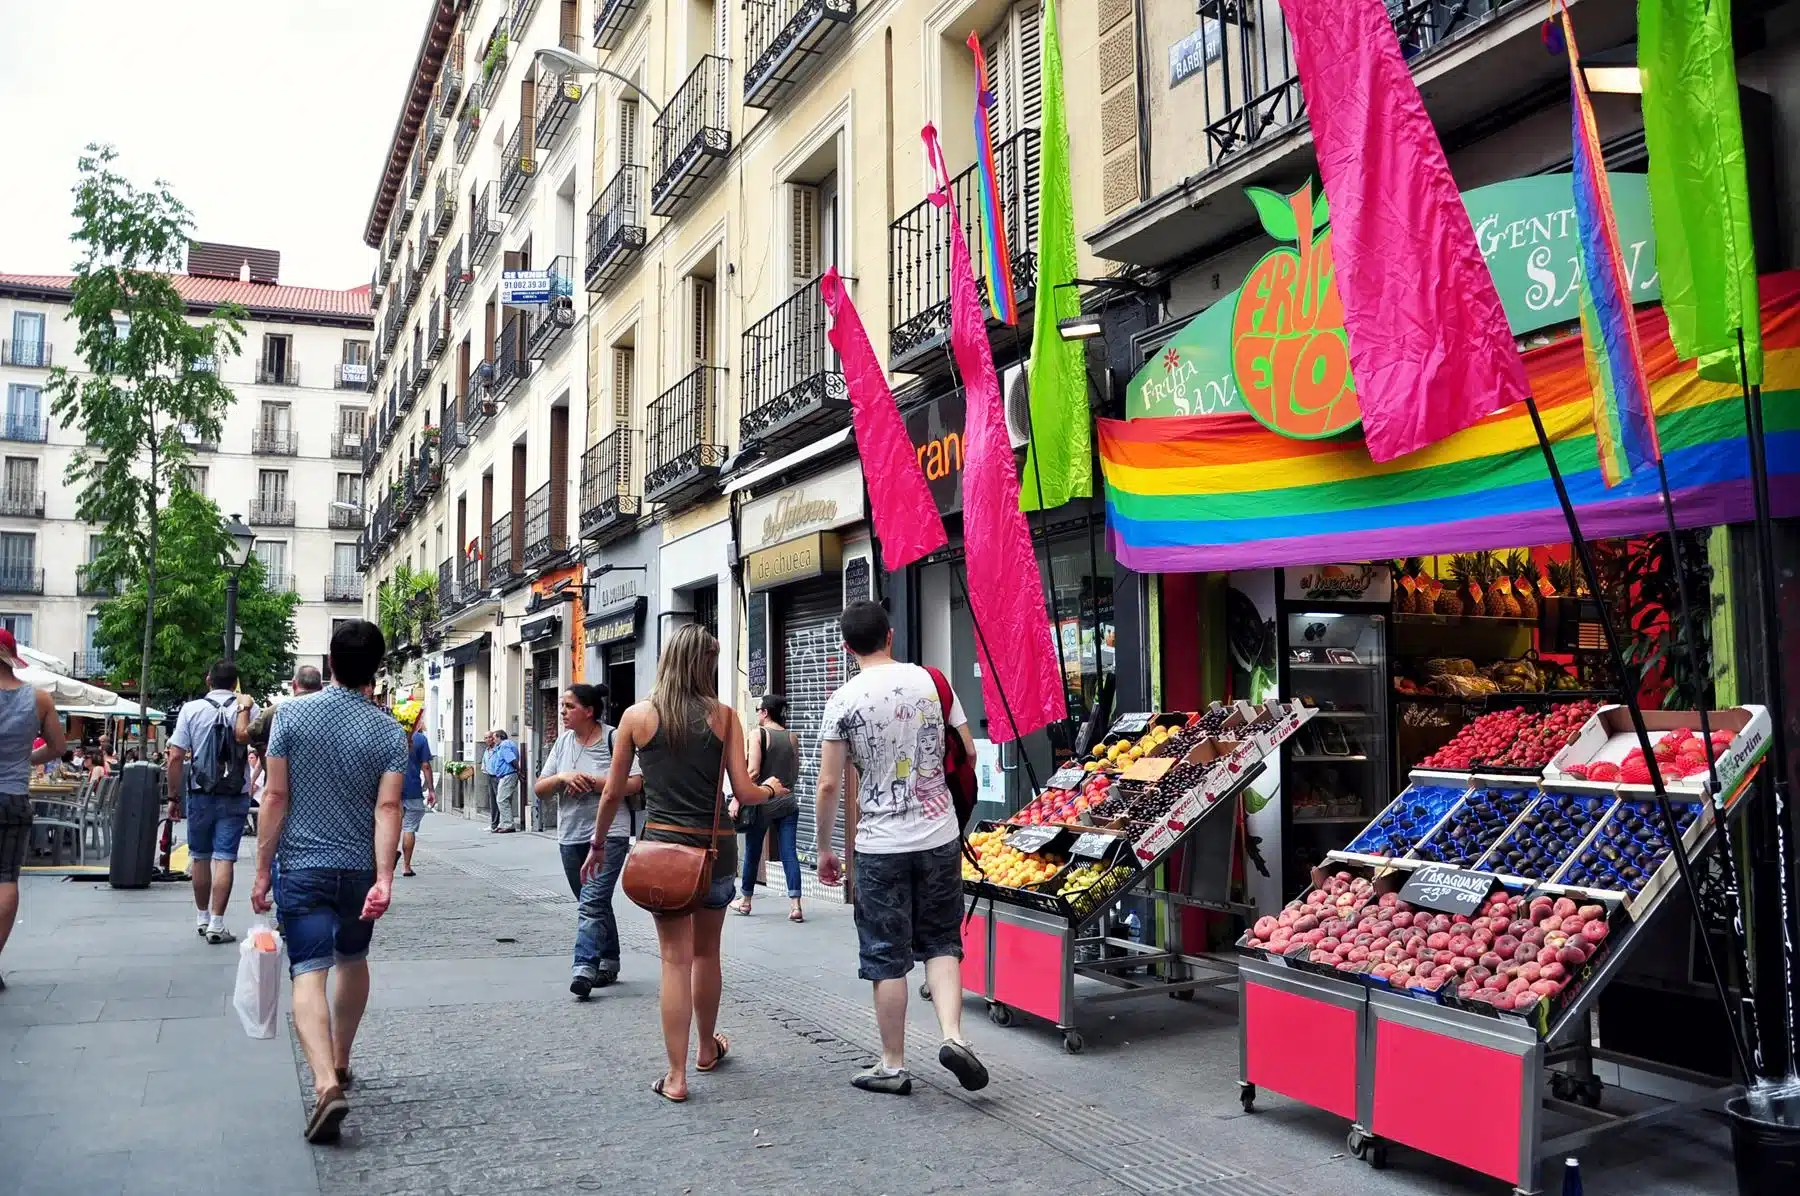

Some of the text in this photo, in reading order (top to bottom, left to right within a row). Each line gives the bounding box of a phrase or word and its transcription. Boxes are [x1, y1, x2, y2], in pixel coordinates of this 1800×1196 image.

[1176, 40, 1217, 80] BARBIRI
[1475, 204, 1577, 258] GENT
[1525, 240, 1660, 311] SAN
[917, 432, 968, 481] ran
[758, 548, 812, 580] de chueca
[1733, 731, 1763, 768] Perlim
[1416, 865, 1493, 897] PARAGUAYAS
